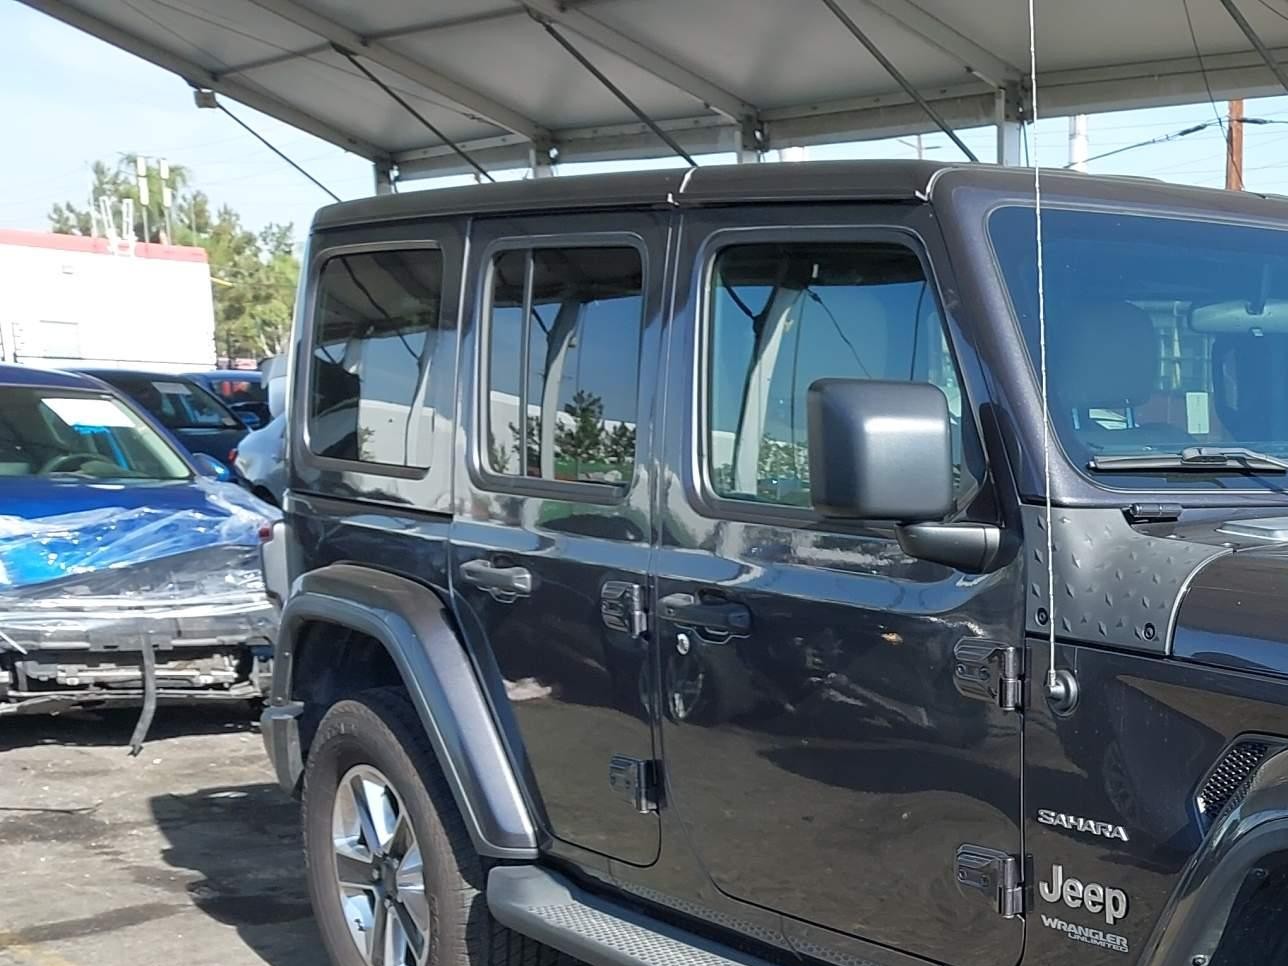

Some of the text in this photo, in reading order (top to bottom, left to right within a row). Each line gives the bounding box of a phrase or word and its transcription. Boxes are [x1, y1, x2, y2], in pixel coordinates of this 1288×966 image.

[1037, 808, 1130, 842] SAHARA
[1038, 863, 1128, 925] Jeep
[1041, 914, 1128, 947] WRANGLER
[1068, 933, 1128, 953] UNLIMITED
